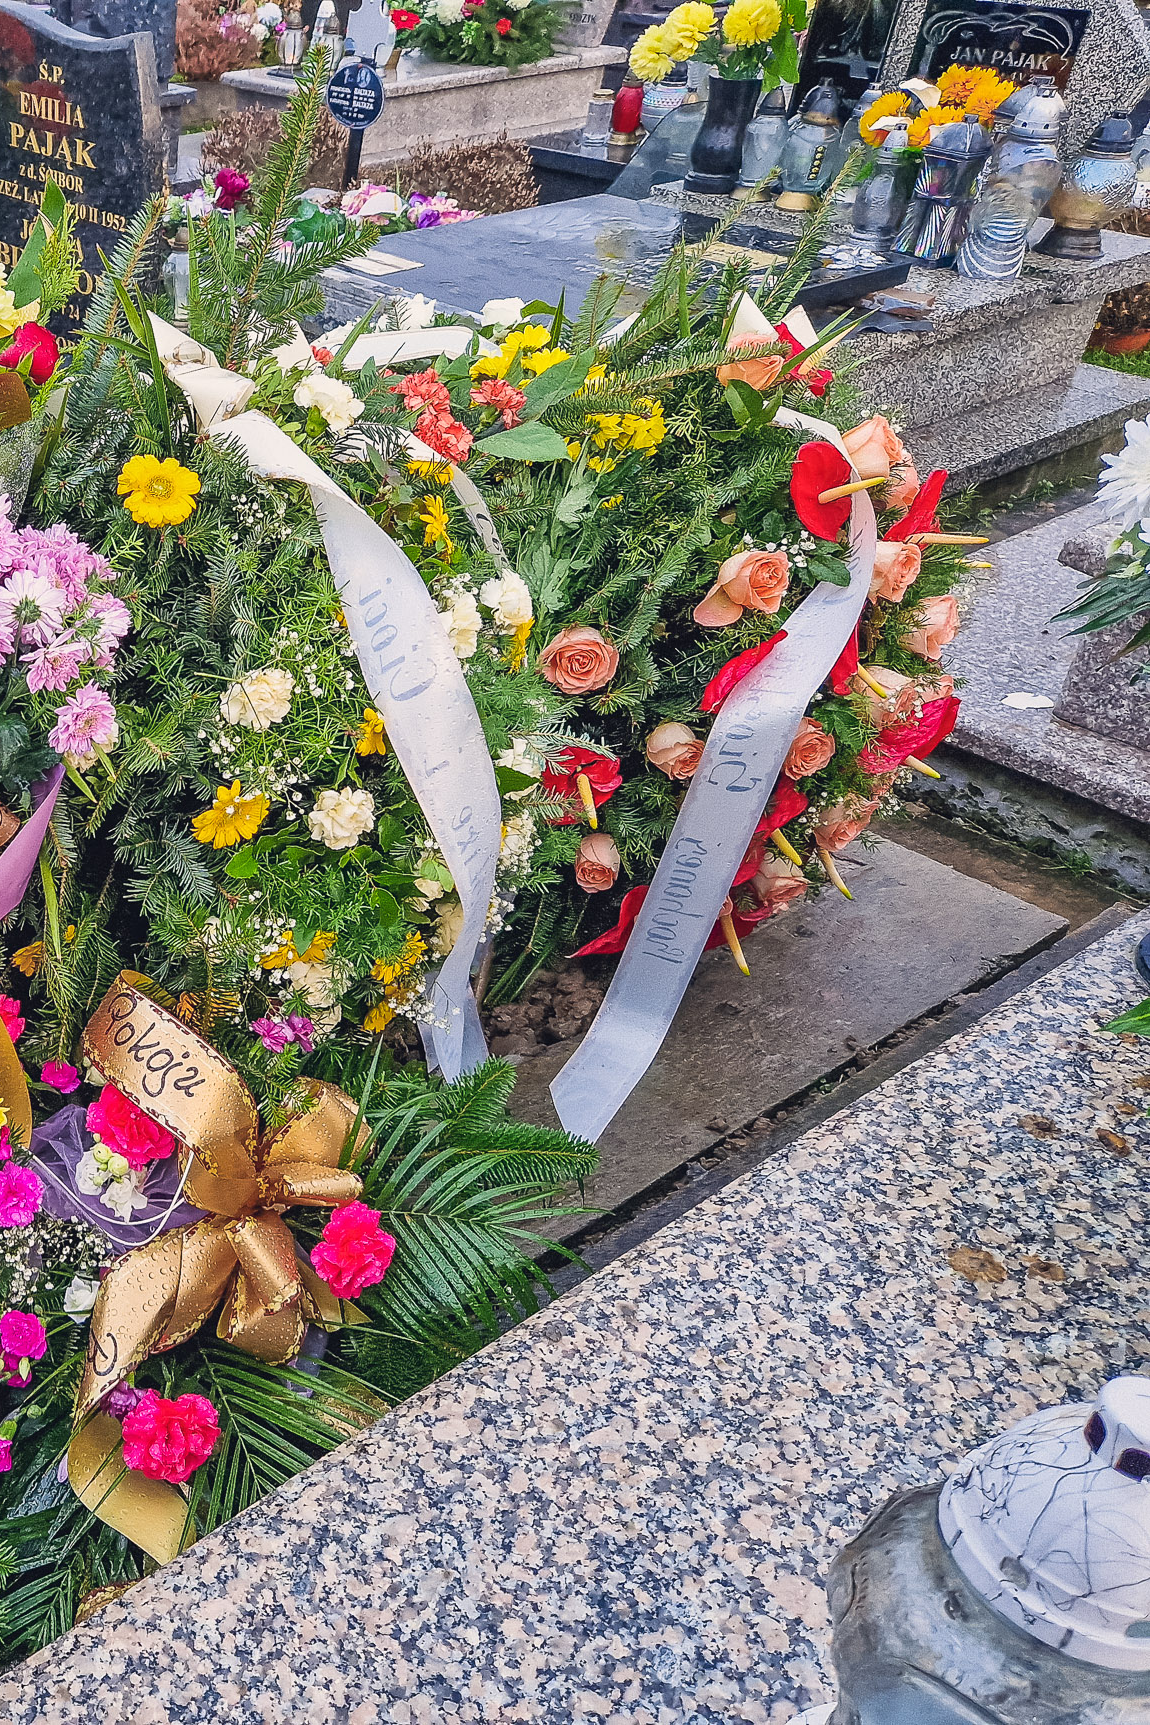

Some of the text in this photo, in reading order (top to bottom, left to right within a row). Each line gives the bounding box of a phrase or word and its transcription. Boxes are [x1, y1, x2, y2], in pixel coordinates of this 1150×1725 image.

[951, 46, 985, 62] JAN
[38, 58, 65, 85] Ś.P.
[19, 91, 86, 129] EMILIA
[9, 121, 97, 170] PAJĄK
[101, 210, 127, 233] 1952
[105, 991, 207, 1099] Pokoju
